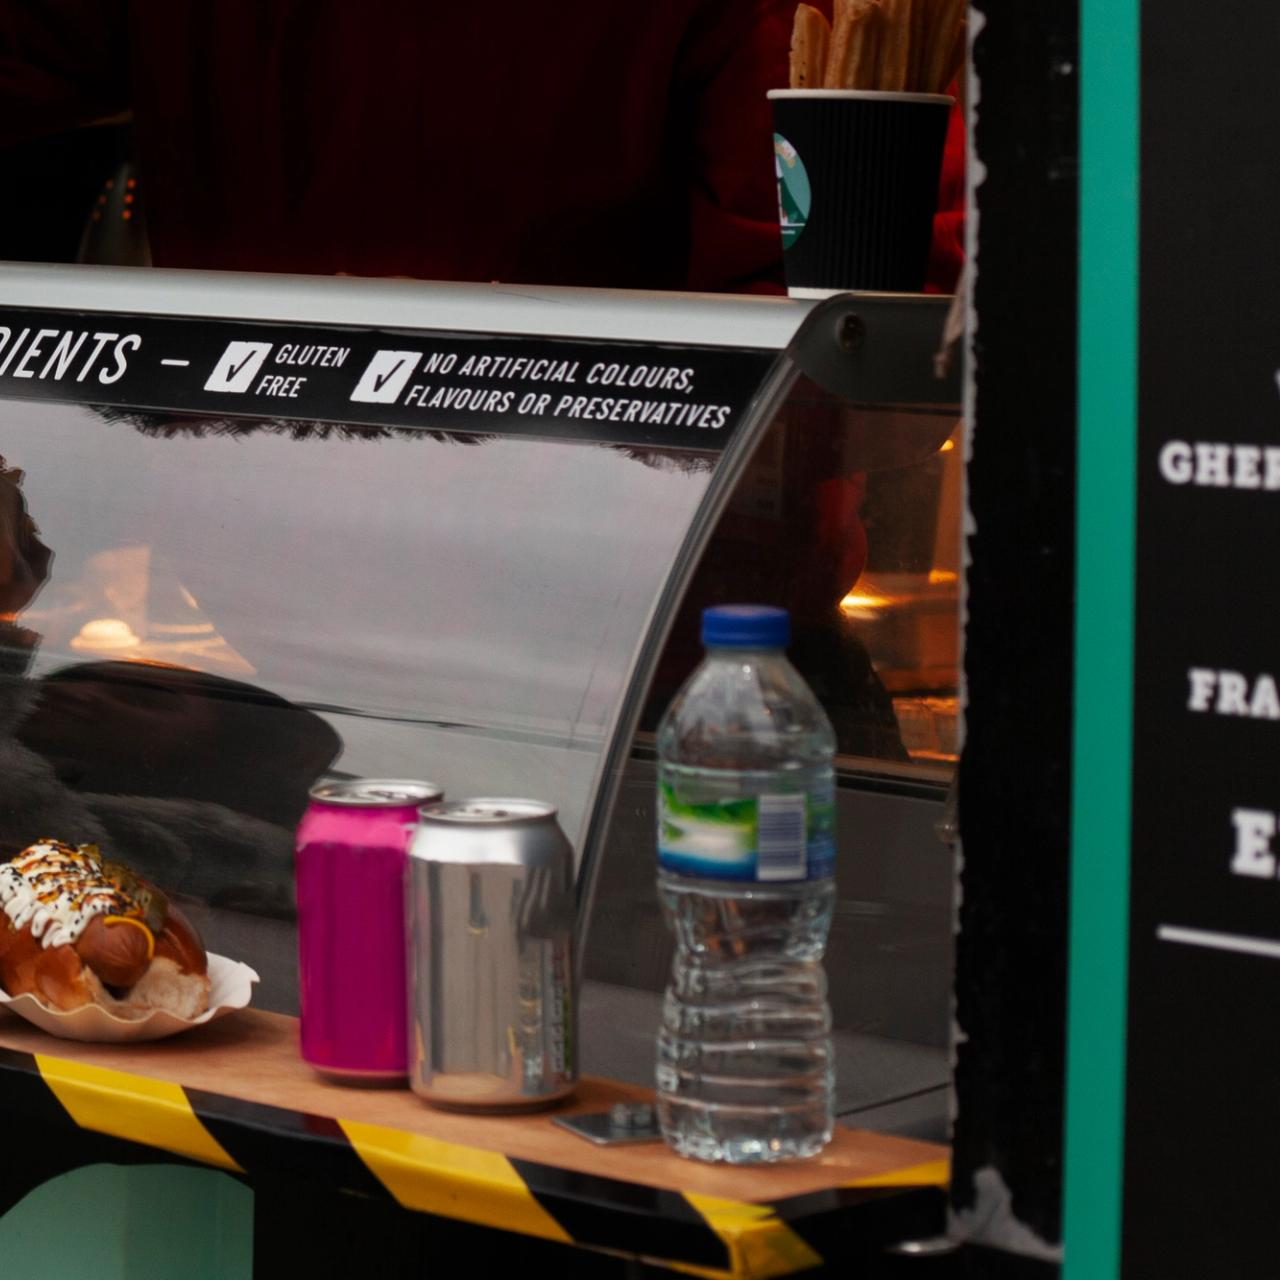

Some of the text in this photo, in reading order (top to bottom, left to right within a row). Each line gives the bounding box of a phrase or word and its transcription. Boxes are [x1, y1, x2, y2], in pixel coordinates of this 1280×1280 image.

[274, 343, 351, 368] GLUTEN
[255, 375, 307, 398] FREE
[423, 352, 694, 394] NO ARTIFICIAL COLOURS,
[404, 384, 731, 429] FLAVOURS OR PRESERVATIVES
